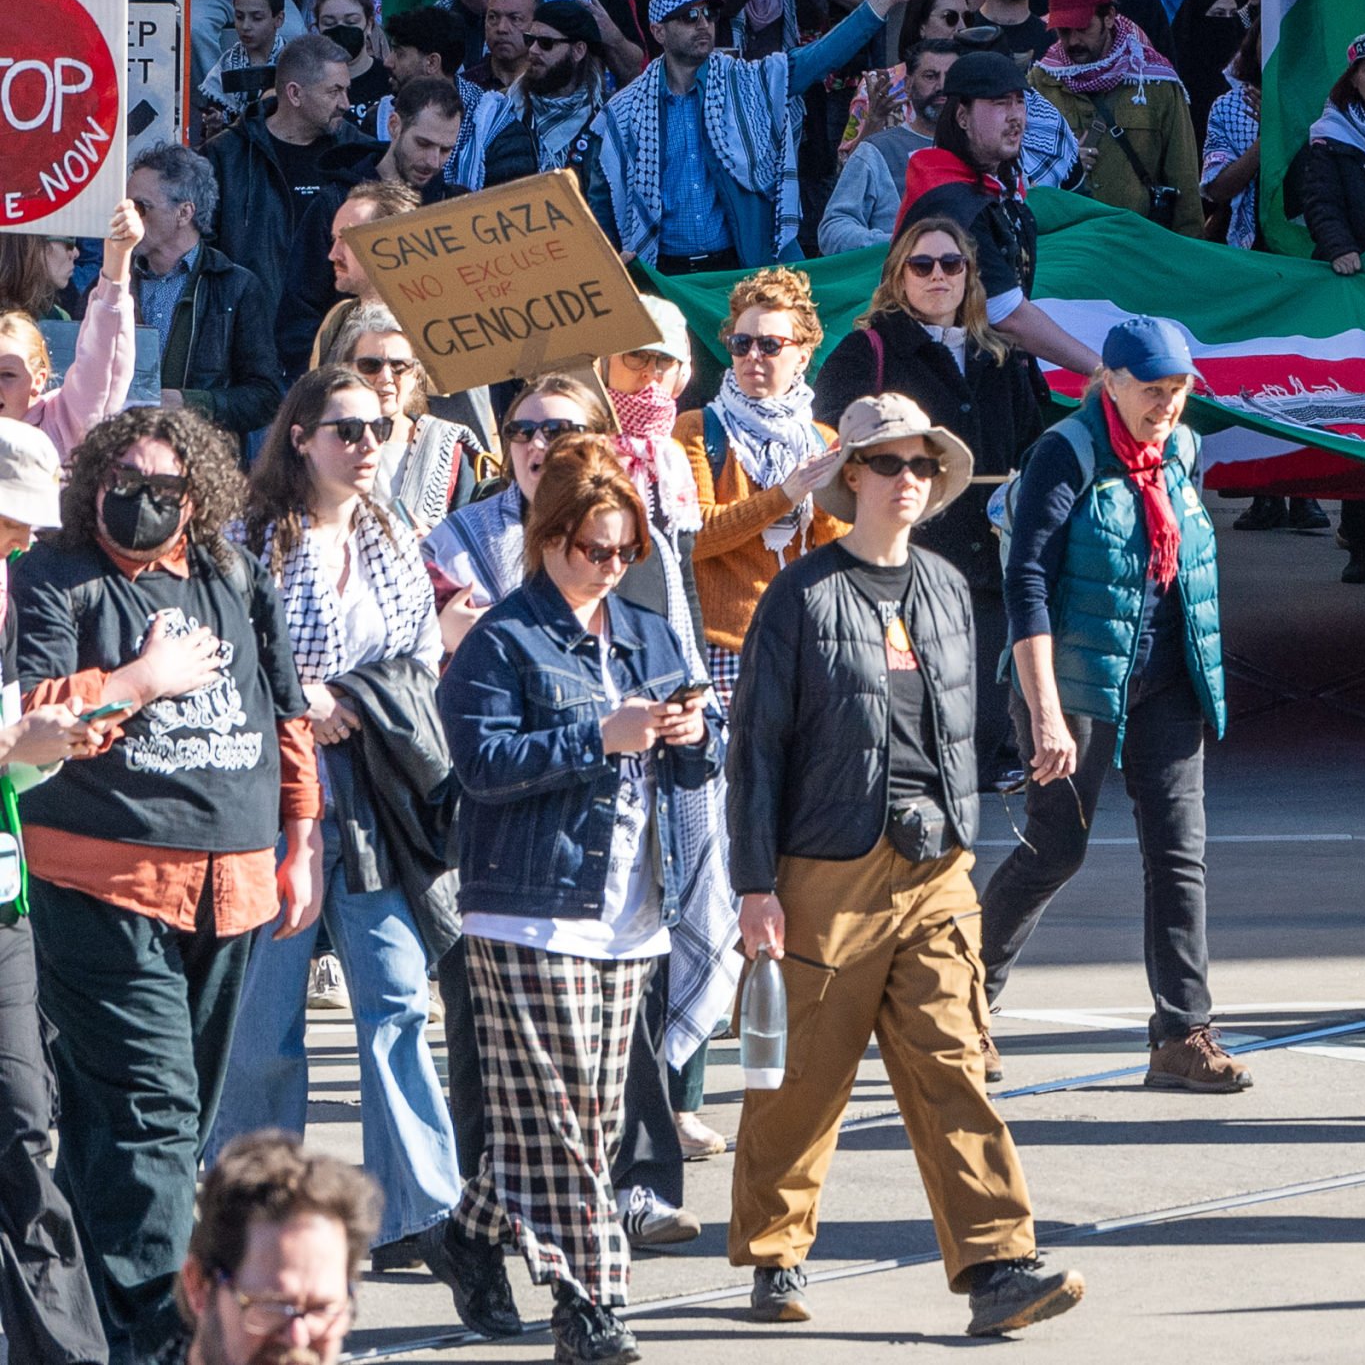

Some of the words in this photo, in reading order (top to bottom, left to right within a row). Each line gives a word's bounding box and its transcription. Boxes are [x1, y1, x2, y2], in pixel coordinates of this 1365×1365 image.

[40, 116, 111, 203] NOW
[6, 192, 24, 218] E
[371, 225, 465, 270] SAVE
[471, 199, 574, 245] GAZA
[398, 274, 444, 303] NO
[457, 240, 569, 286] EXCUSE
[474, 281, 516, 303] FOR
[422, 280, 612, 356] GENOCIDE
